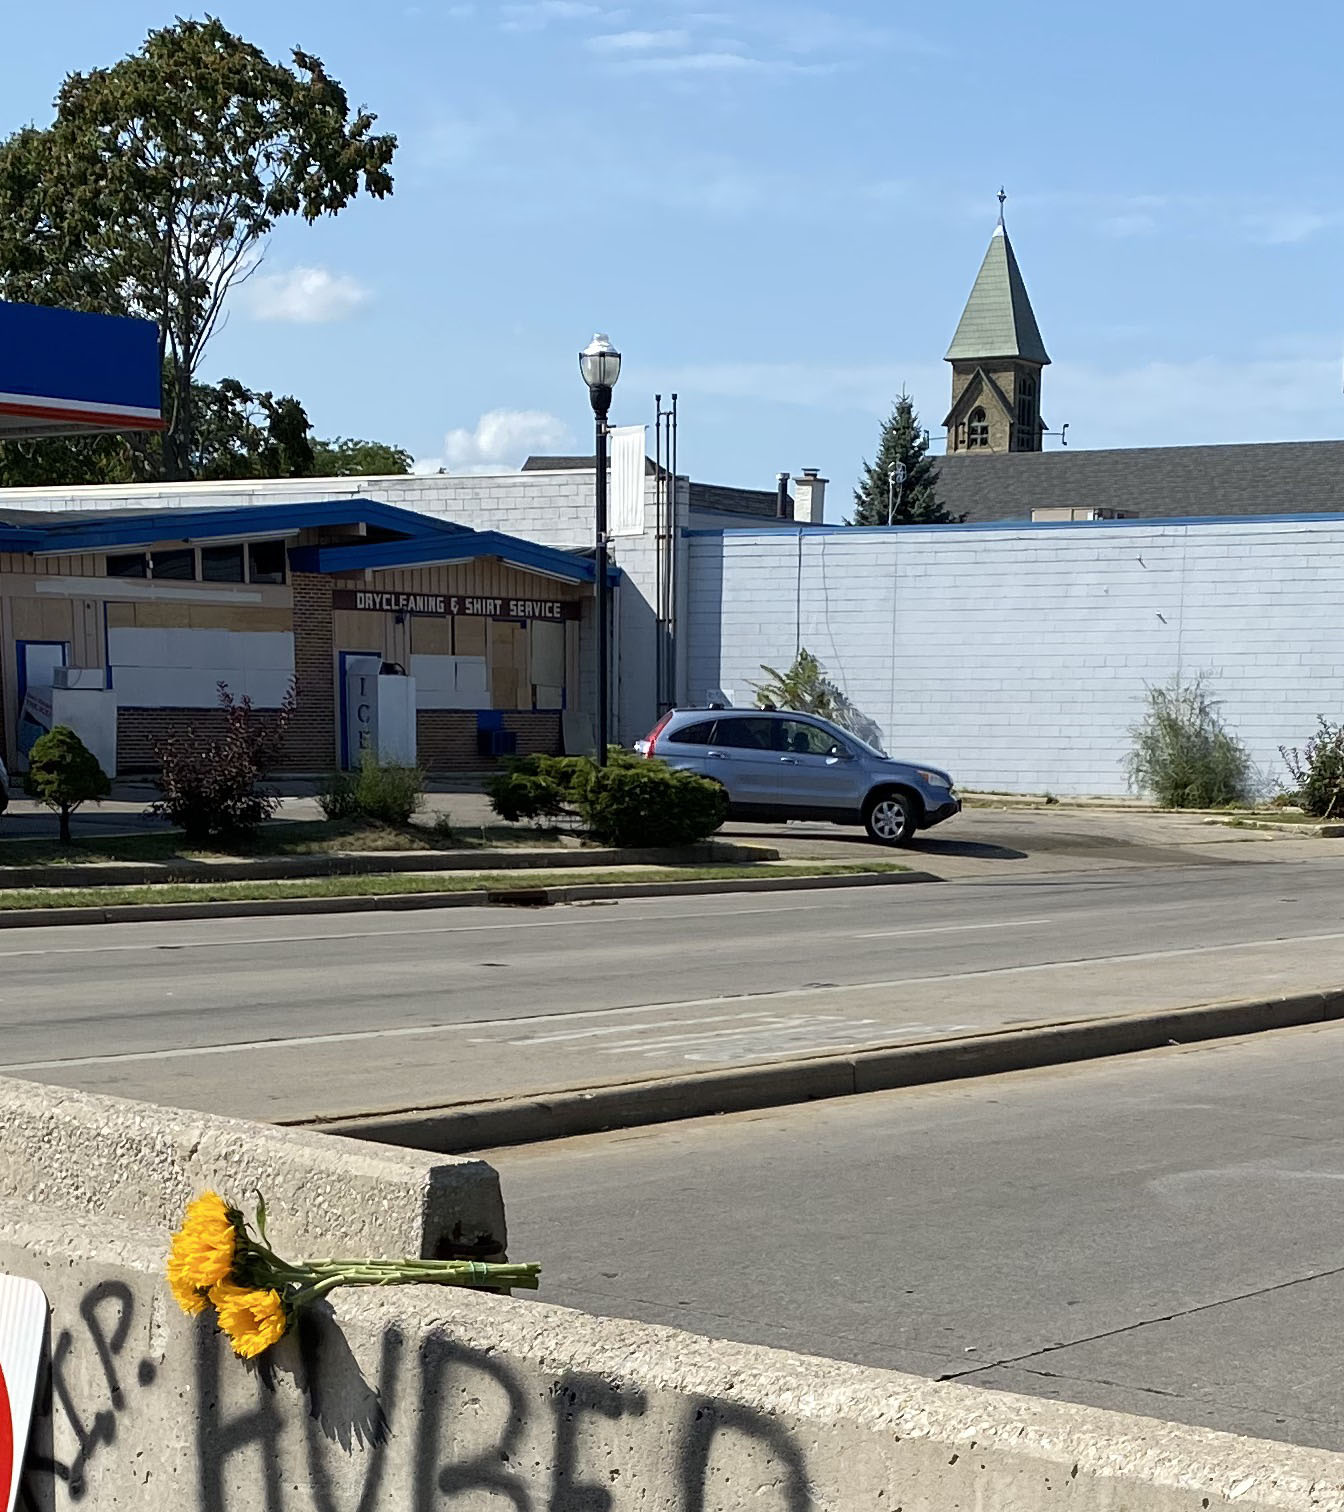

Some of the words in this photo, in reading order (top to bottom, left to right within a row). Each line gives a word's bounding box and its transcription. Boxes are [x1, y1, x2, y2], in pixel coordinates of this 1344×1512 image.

[356, 592, 445, 613] DRYCLEANING
[450, 598, 460, 614] &
[465, 599, 502, 616] SHIRT
[509, 601, 561, 618] SERVICE
[357, 677, 371, 750] ICE
